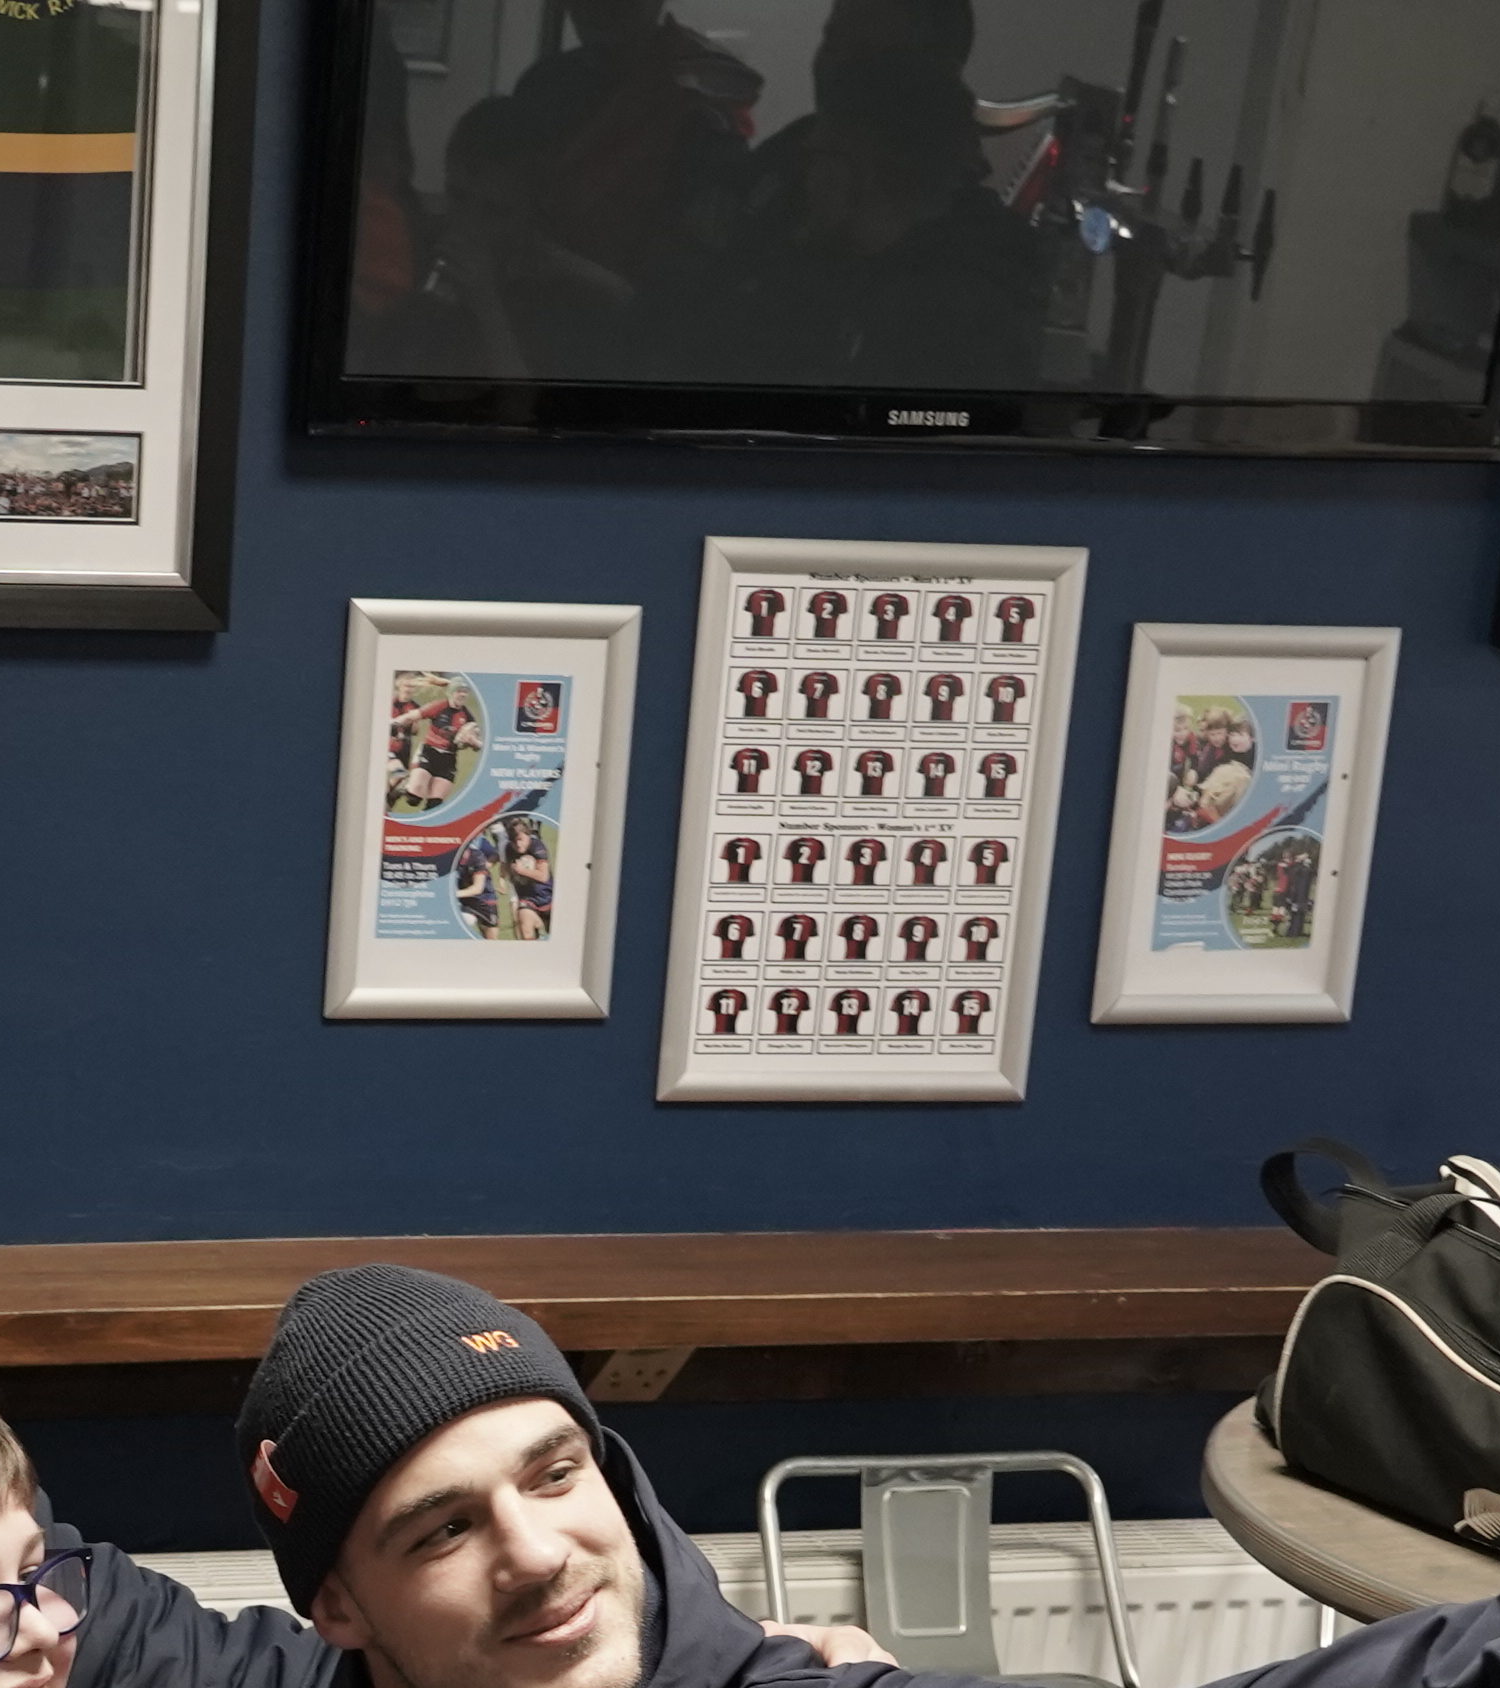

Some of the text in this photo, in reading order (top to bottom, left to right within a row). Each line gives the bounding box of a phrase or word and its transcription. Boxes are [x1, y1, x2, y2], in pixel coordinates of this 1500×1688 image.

[887, 410, 970, 427] SAMSUNG
[761, 601, 1020, 623] 1 2 3 4 5
[814, 683, 824, 699] 7
[999, 687, 1014, 703] 10
[743, 759, 1006, 780] 11 12 13 14 15
[736, 847, 994, 866] 1 2 3 4 5
[793, 924, 802, 940] 7
[971, 926, 987, 942] 10
[720, 998, 980, 1015] 11 12 13 14 15
[461, 1331, 520, 1353] WG
